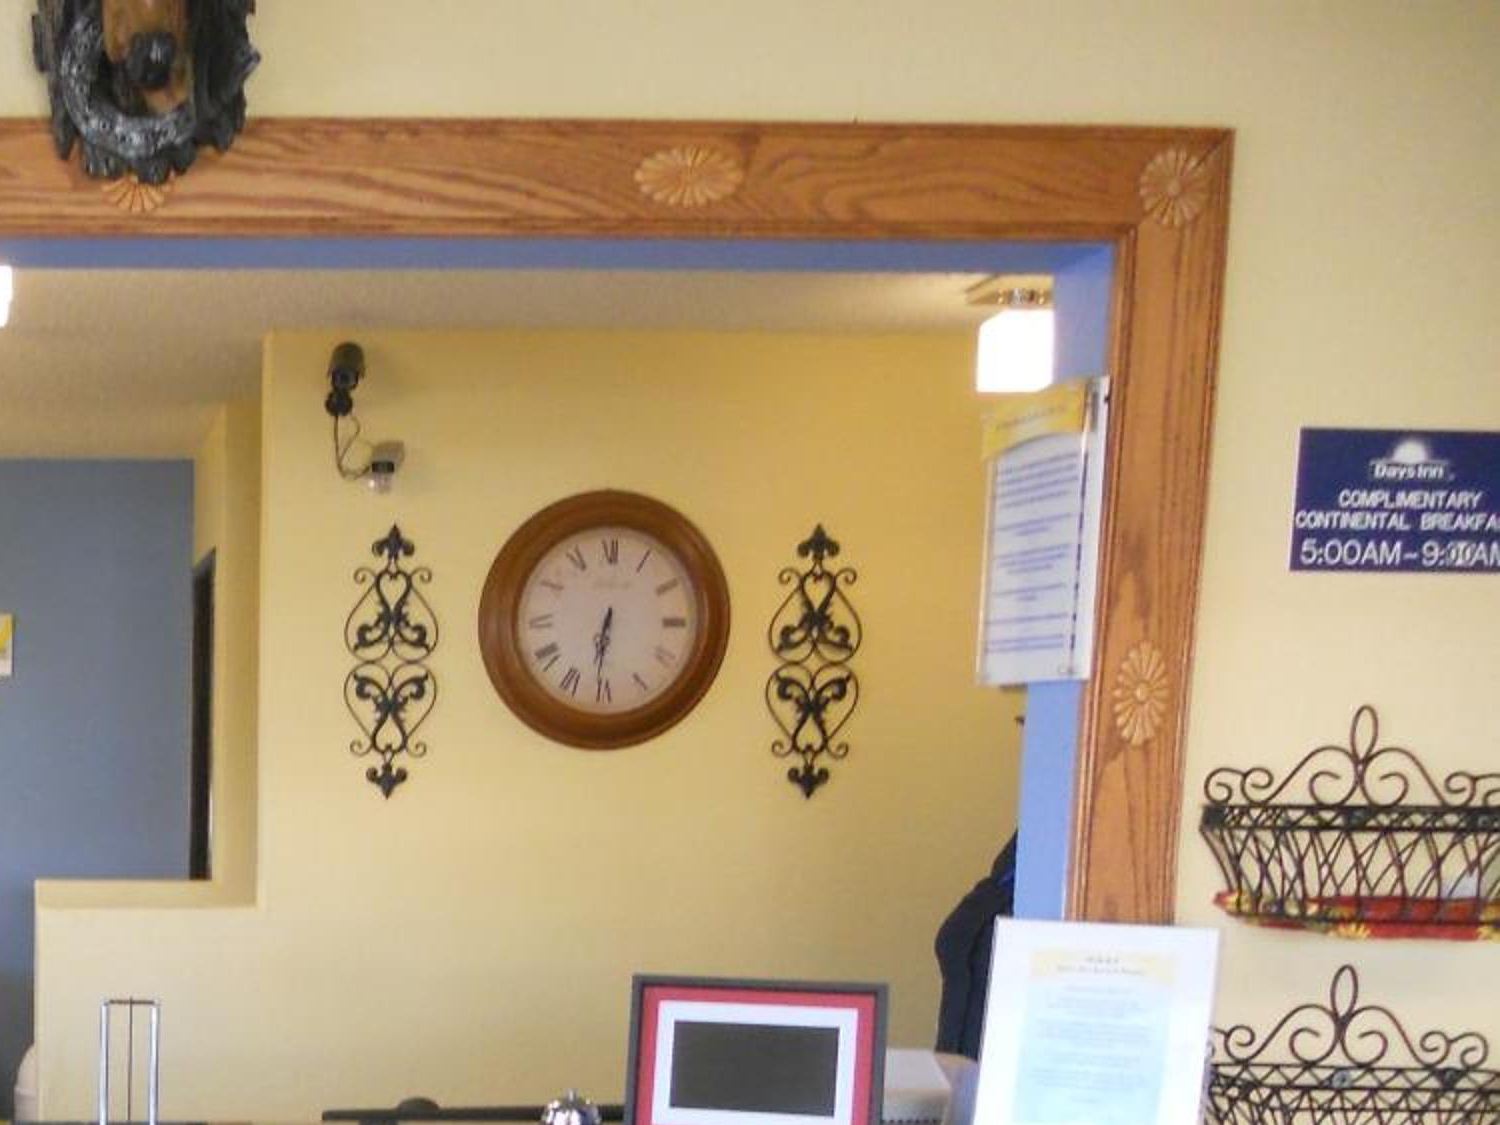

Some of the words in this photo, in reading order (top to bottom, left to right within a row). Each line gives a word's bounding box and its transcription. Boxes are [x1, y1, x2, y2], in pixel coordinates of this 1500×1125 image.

[1373, 463, 1414, 480] Days
[1417, 464, 1444, 479] Inn
[1338, 489, 1483, 509] COMPLIMENTARY
[1295, 510, 1411, 531] CONTINENTAL
